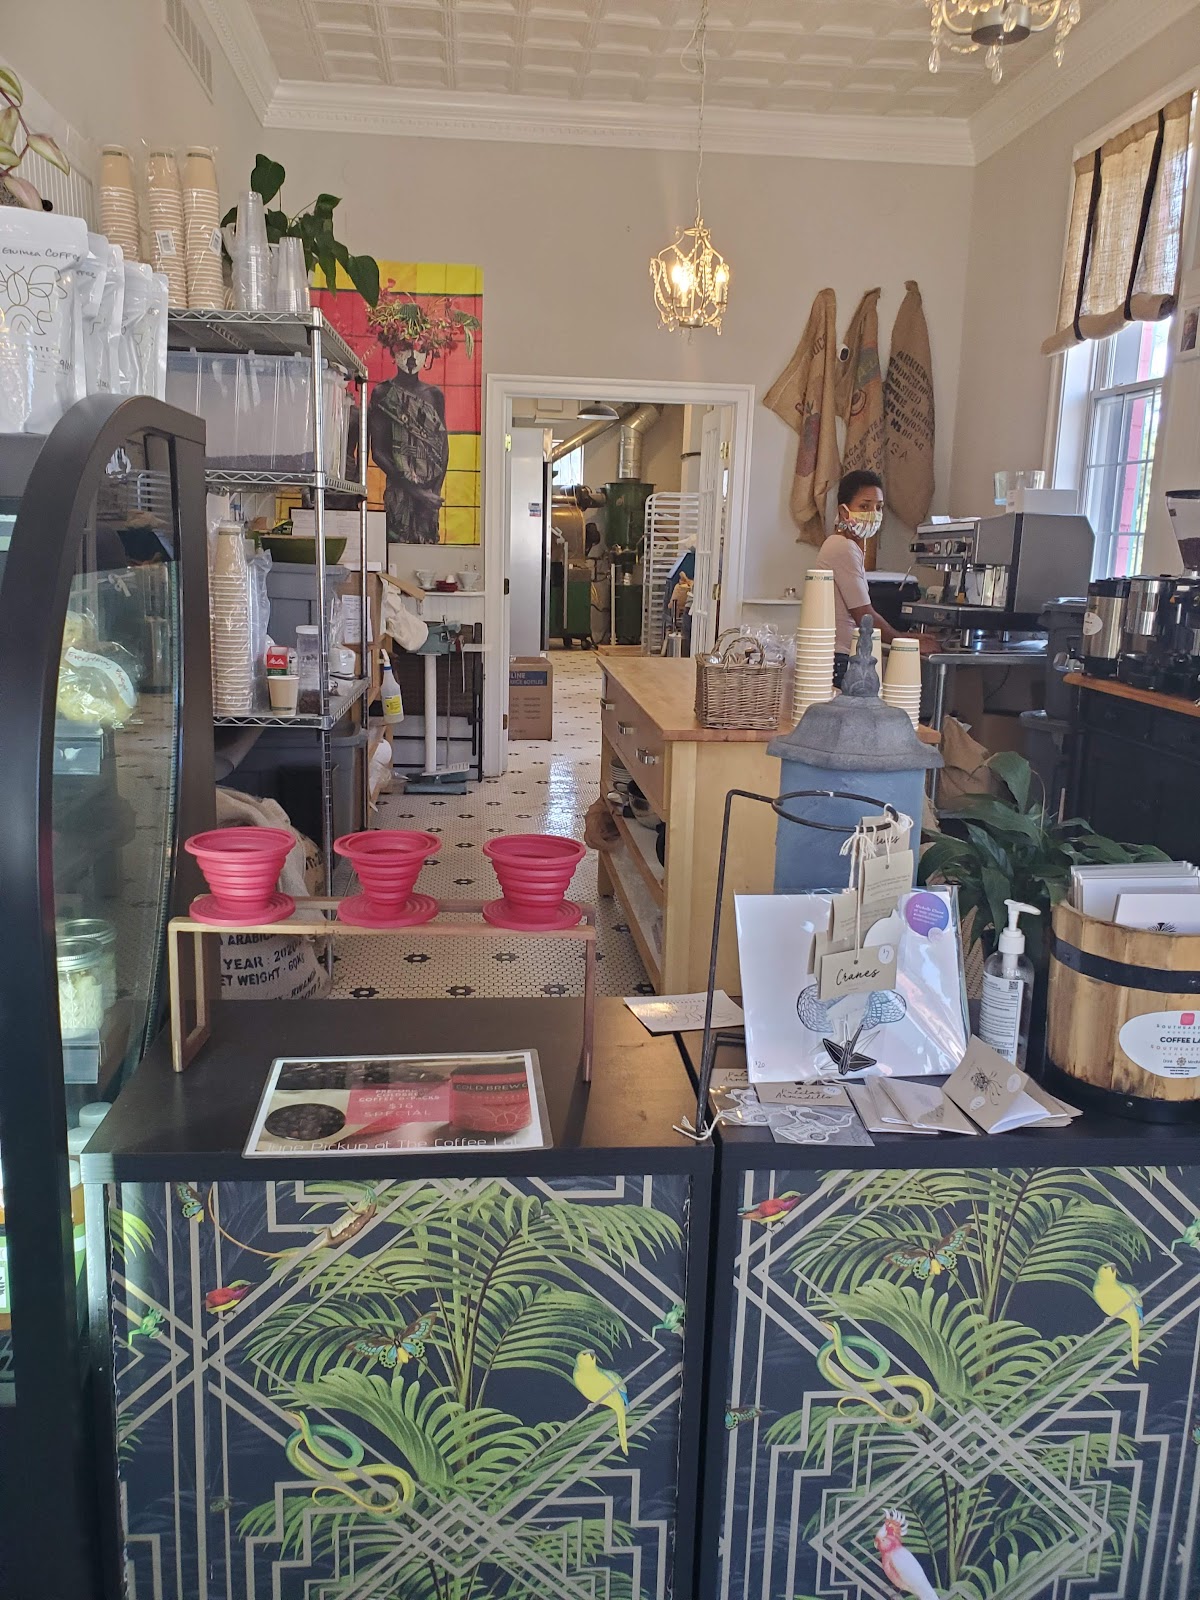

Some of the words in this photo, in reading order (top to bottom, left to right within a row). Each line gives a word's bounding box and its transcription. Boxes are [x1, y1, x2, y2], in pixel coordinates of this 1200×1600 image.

[223, 957, 263, 971] YEAR
[237, 966, 280, 987] WEIGHT
[836, 968, 880, 986] Cranes
[1160, 1036, 1191, 1044] COFFEE
[486, 1082, 519, 1091] BREW
[364, 1109, 431, 1117] SPECIAL
[398, 1139, 428, 1149] The
[434, 1137, 487, 1147] Coffee
